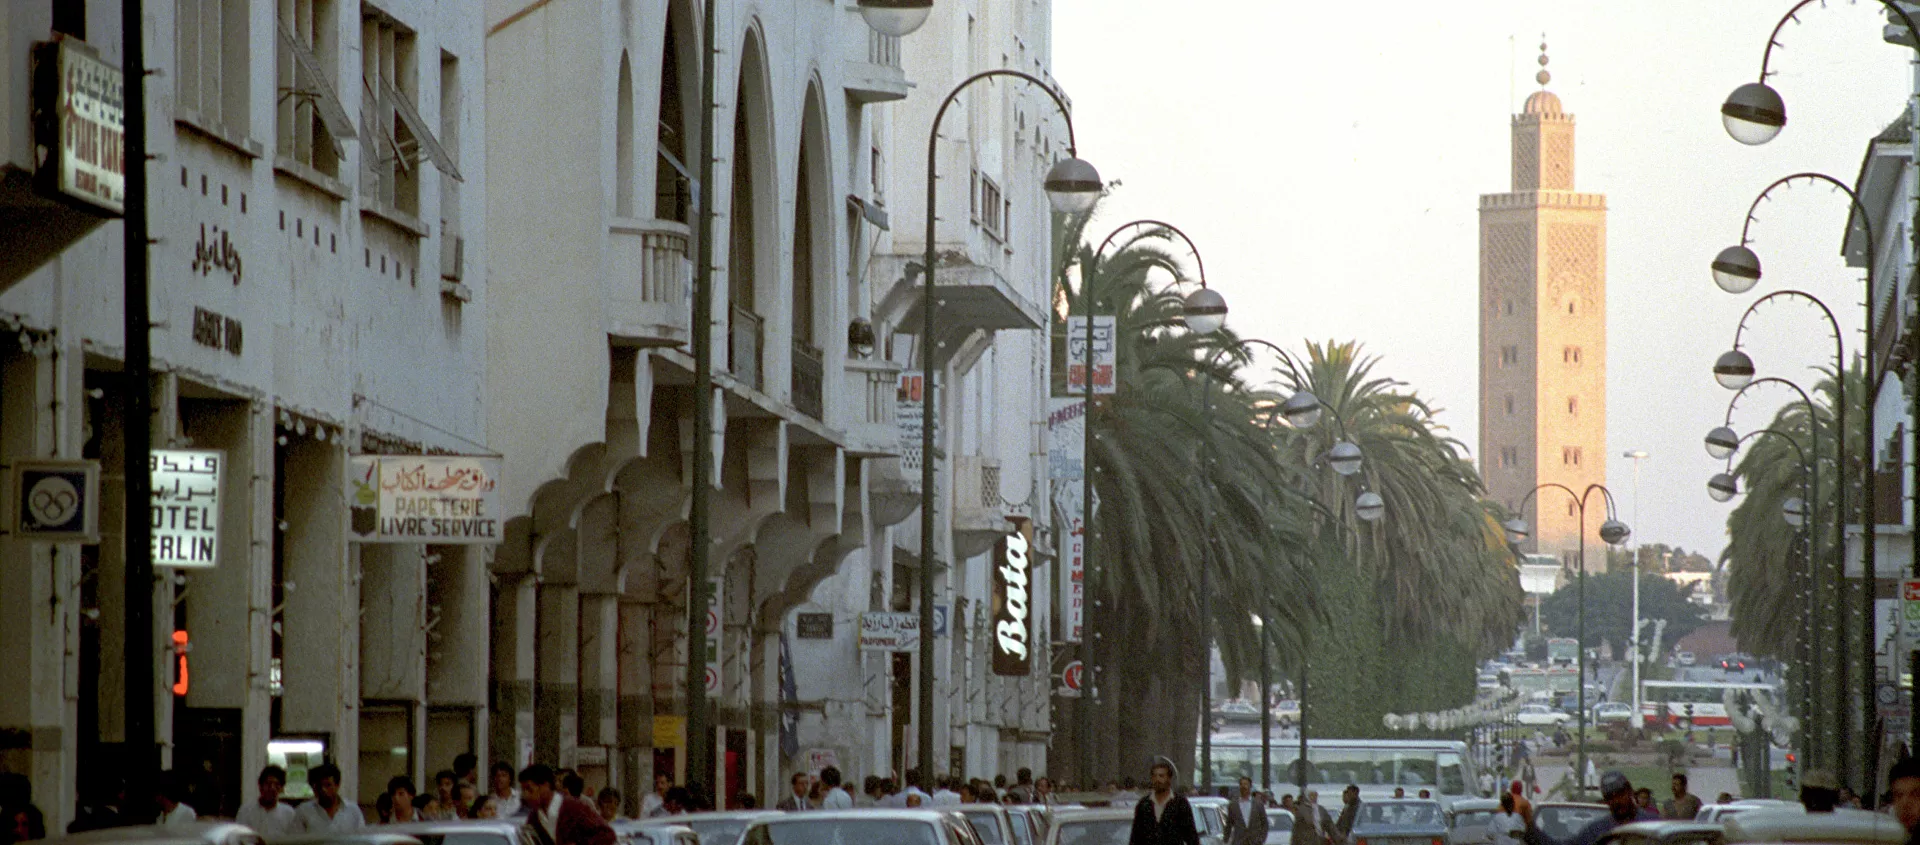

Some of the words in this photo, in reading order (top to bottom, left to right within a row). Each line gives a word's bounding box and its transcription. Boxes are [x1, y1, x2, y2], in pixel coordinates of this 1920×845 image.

[150, 505, 215, 532] OTEL
[395, 497, 485, 517] PAPETERIE
[381, 517, 426, 538] LIVRE
[431, 518, 497, 539] SERVICE
[150, 535, 214, 562] ERLIN
[998, 530, 1030, 661] Bata
